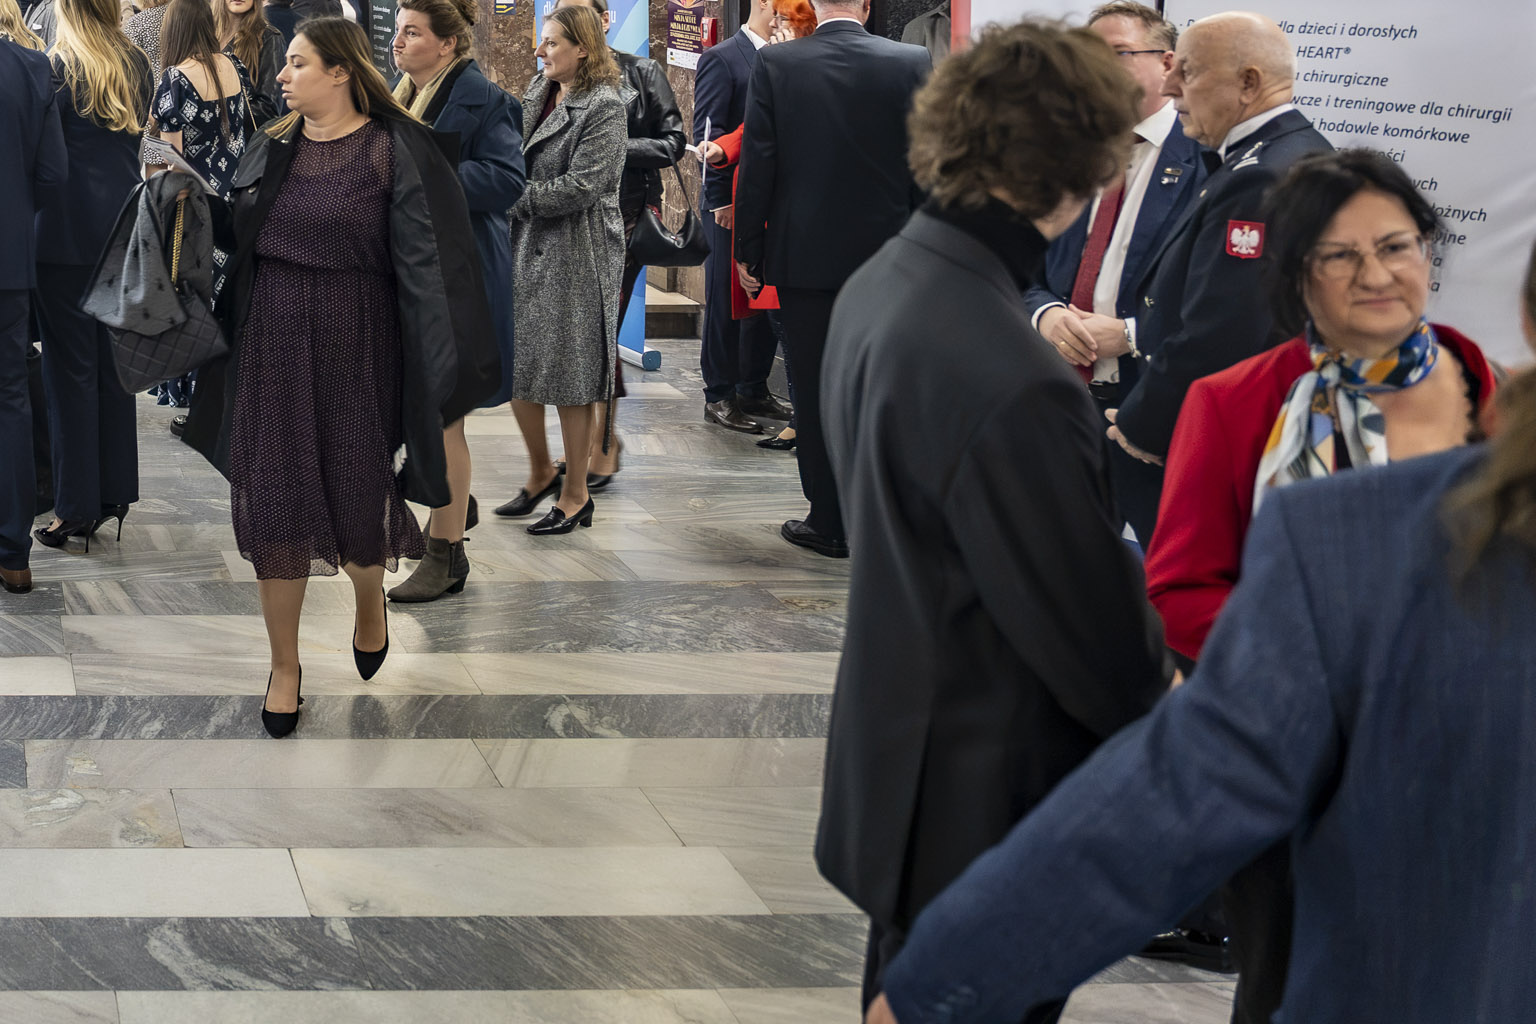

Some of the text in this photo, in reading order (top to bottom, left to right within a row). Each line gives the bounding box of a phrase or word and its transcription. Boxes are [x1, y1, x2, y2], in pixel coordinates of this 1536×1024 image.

[1298, 22, 1338, 37] dzieci
[1340, 24, 1346, 37] i
[1348, 23, 1419, 41] dorosłych
[1303, 69, 1390, 88] chirurgiczne
[1290, 95, 1513, 124] wcze i treningowe dla chirurgii
[1318, 118, 1380, 138] hodowle
[1382, 124, 1471, 145] komórkowe
